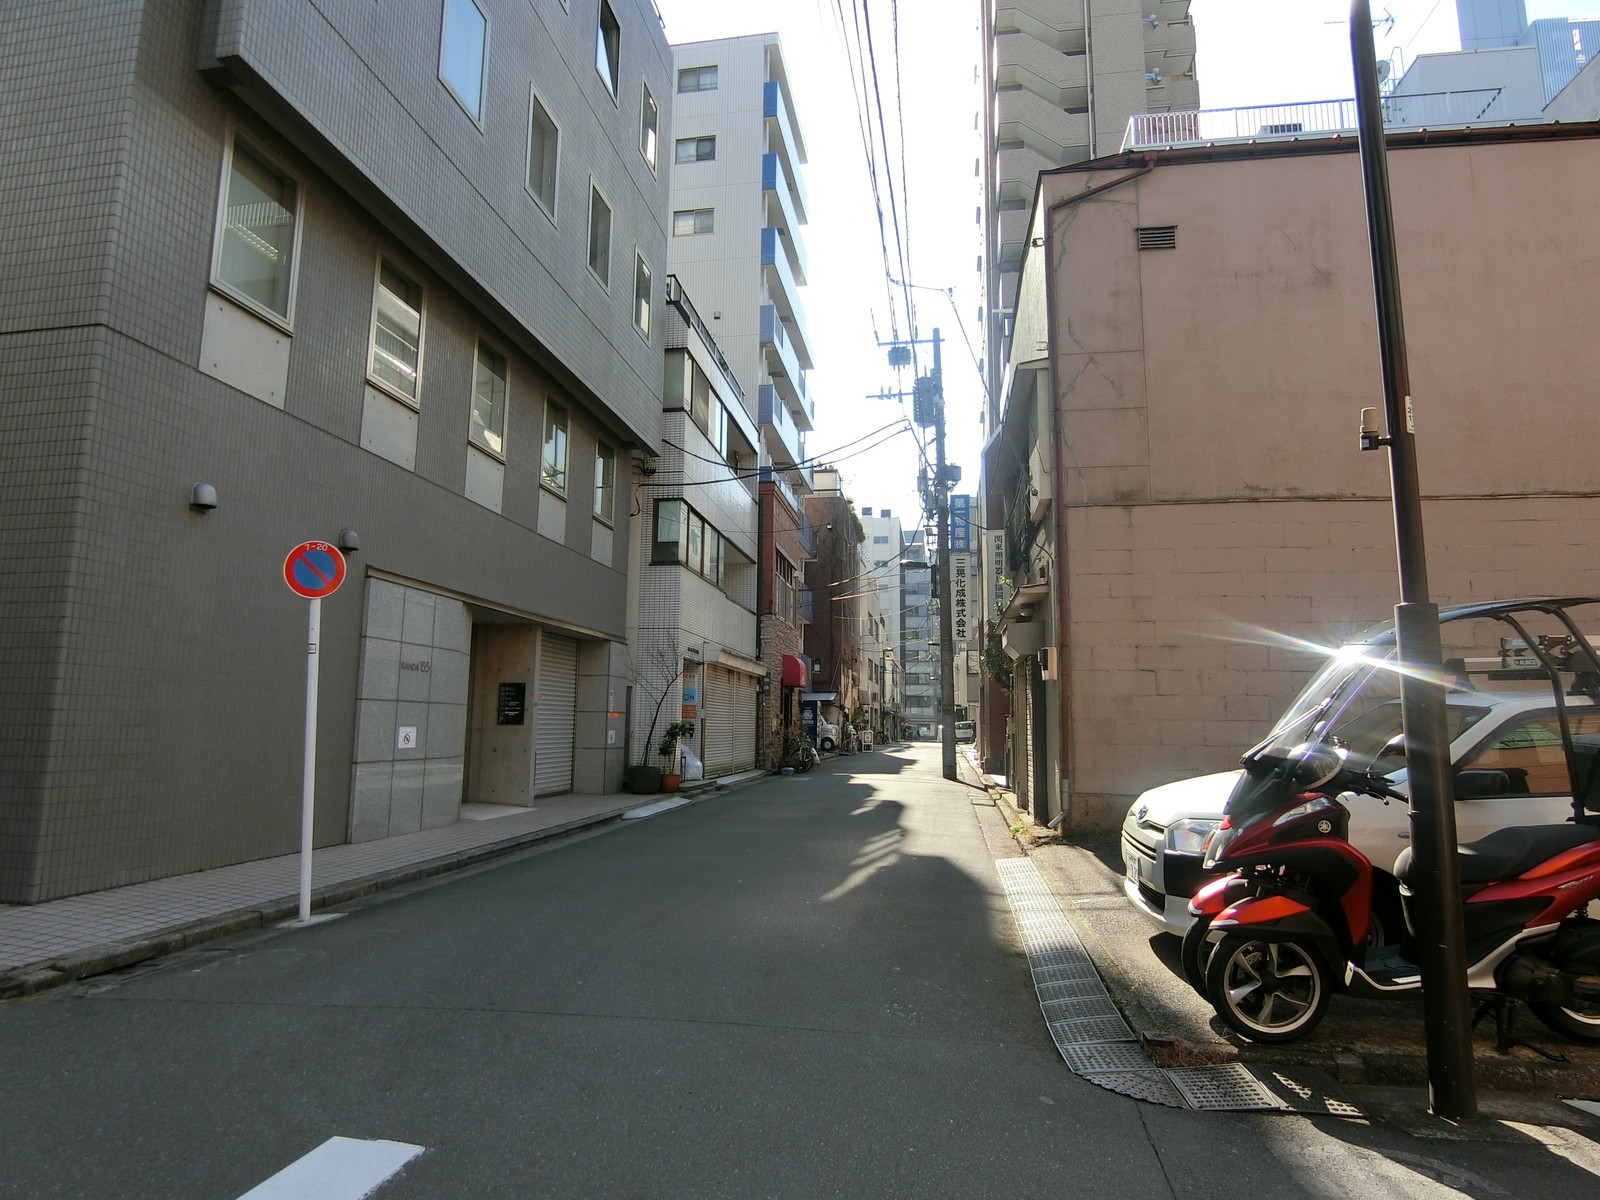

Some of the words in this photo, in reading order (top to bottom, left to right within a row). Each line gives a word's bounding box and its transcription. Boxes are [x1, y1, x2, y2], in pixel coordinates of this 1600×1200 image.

[304, 543, 328, 552] 7-20
[954, 557, 967, 638] 三晃化成株式会社
